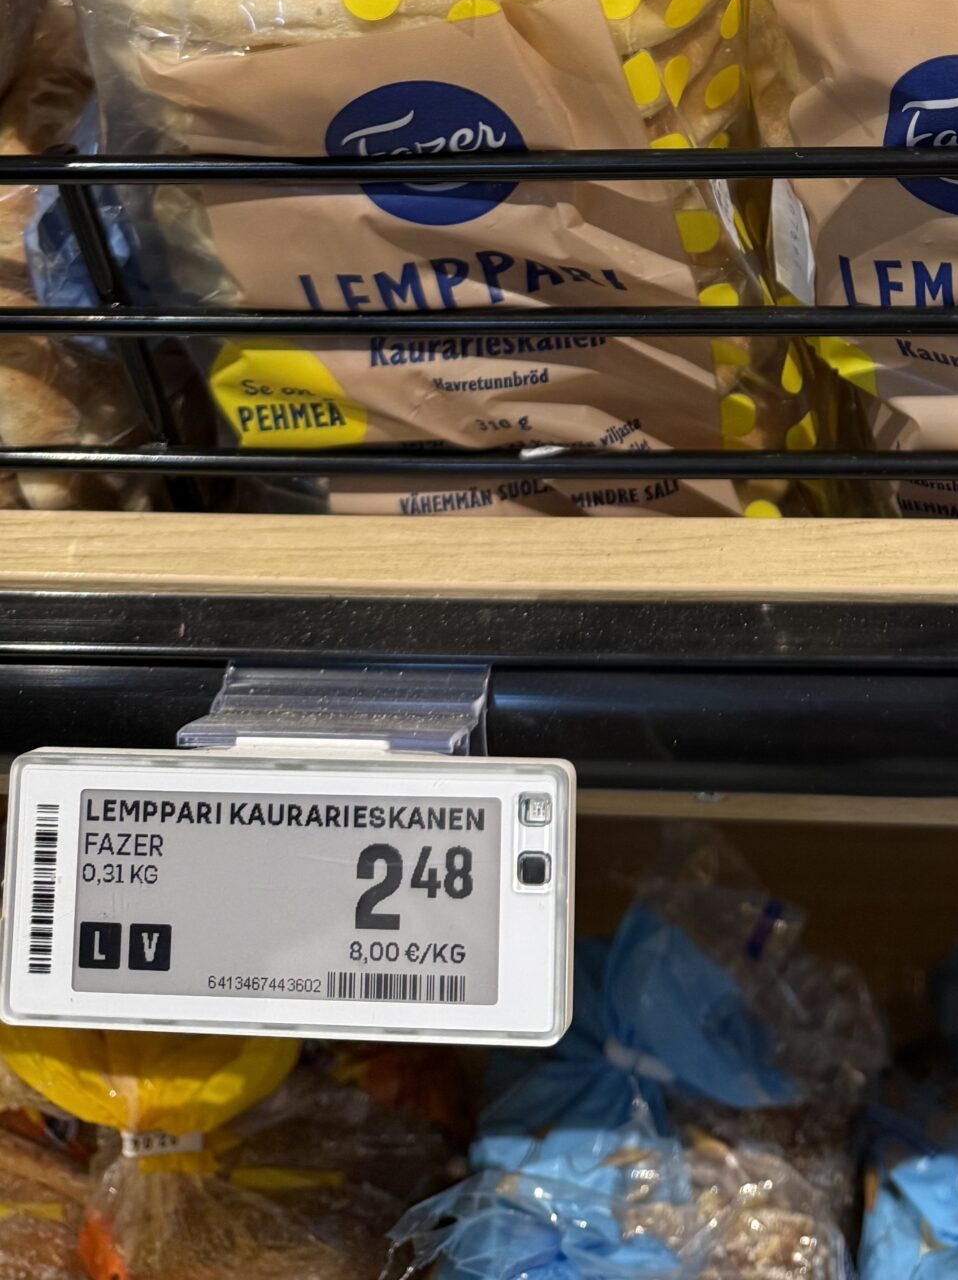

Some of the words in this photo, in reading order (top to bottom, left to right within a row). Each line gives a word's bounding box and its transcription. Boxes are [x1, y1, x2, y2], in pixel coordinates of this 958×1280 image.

[433, 368, 550, 393] Havretunnbröd
[237, 397, 347, 432] PEHMEÄ
[400, 488, 493, 517] VÄHEMMÄN
[571, 487, 640, 508] MINDRE
[85, 798, 223, 826] LEMPPARI
[230, 802, 486, 831] KAURARIESKANEN
[84, 832, 164, 857] FAZER
[82, 862, 126, 886] 0,31
[129, 863, 159, 885] KG
[354, 842, 404, 931] 2
[410, 844, 474, 900] 48
[93, 930, 106, 961] L
[141, 931, 160, 962] V
[349, 940, 401, 965] 8,00
[404, 942, 467, 965] €/KG
[207, 974, 322, 994] 6413467443602
